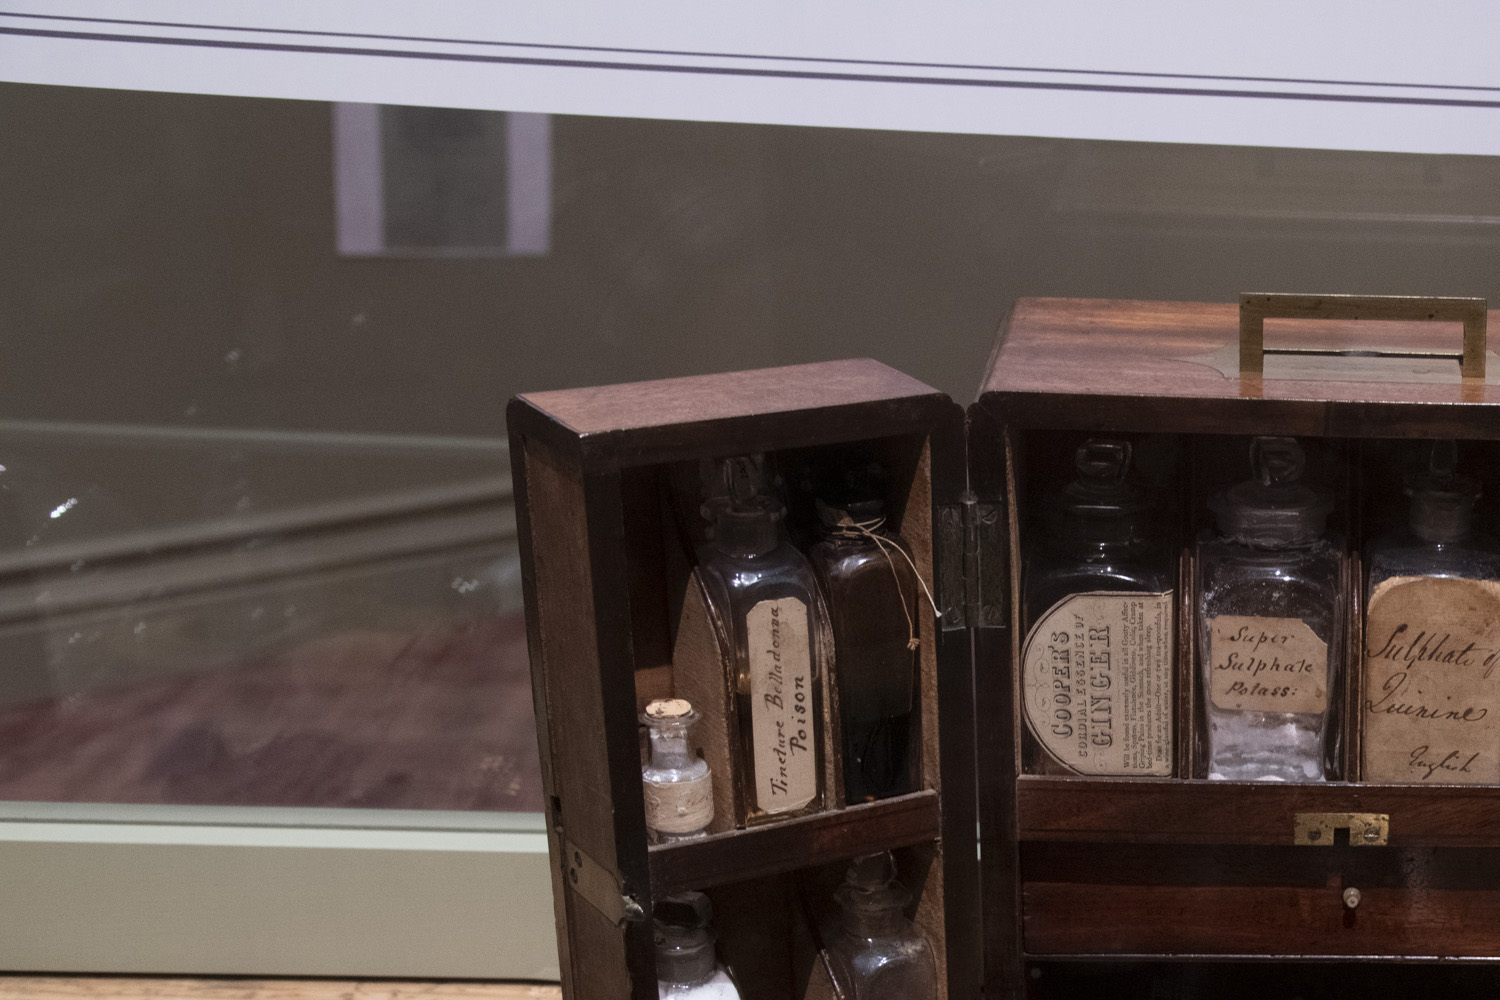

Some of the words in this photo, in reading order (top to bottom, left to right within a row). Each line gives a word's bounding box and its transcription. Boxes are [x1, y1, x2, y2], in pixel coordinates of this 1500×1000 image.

[1073, 614, 1084, 628] OF
[1129, 602, 1137, 624] Cramp
[1129, 627, 1137, 646] Colic,
[764, 605, 784, 711] Belladonna
[1227, 626, 1295, 652] Super
[1367, 623, 1493, 670] Sulphate
[1048, 632, 1072, 738] COOPER'S
[1074, 633, 1086, 696] ESSENCE
[1088, 626, 1112, 748] GINGER
[1214, 652, 1313, 677] Sulphate
[789, 675, 808, 756] Poison
[1122, 689, 1130, 721] extremely
[1365, 672, 1488, 721] Quinine
[1077, 700, 1087, 758] CORDIAL
[1157, 725, 1161, 733] an
[770, 720, 788, 796] Tincture
[1408, 745, 1480, 780] English
